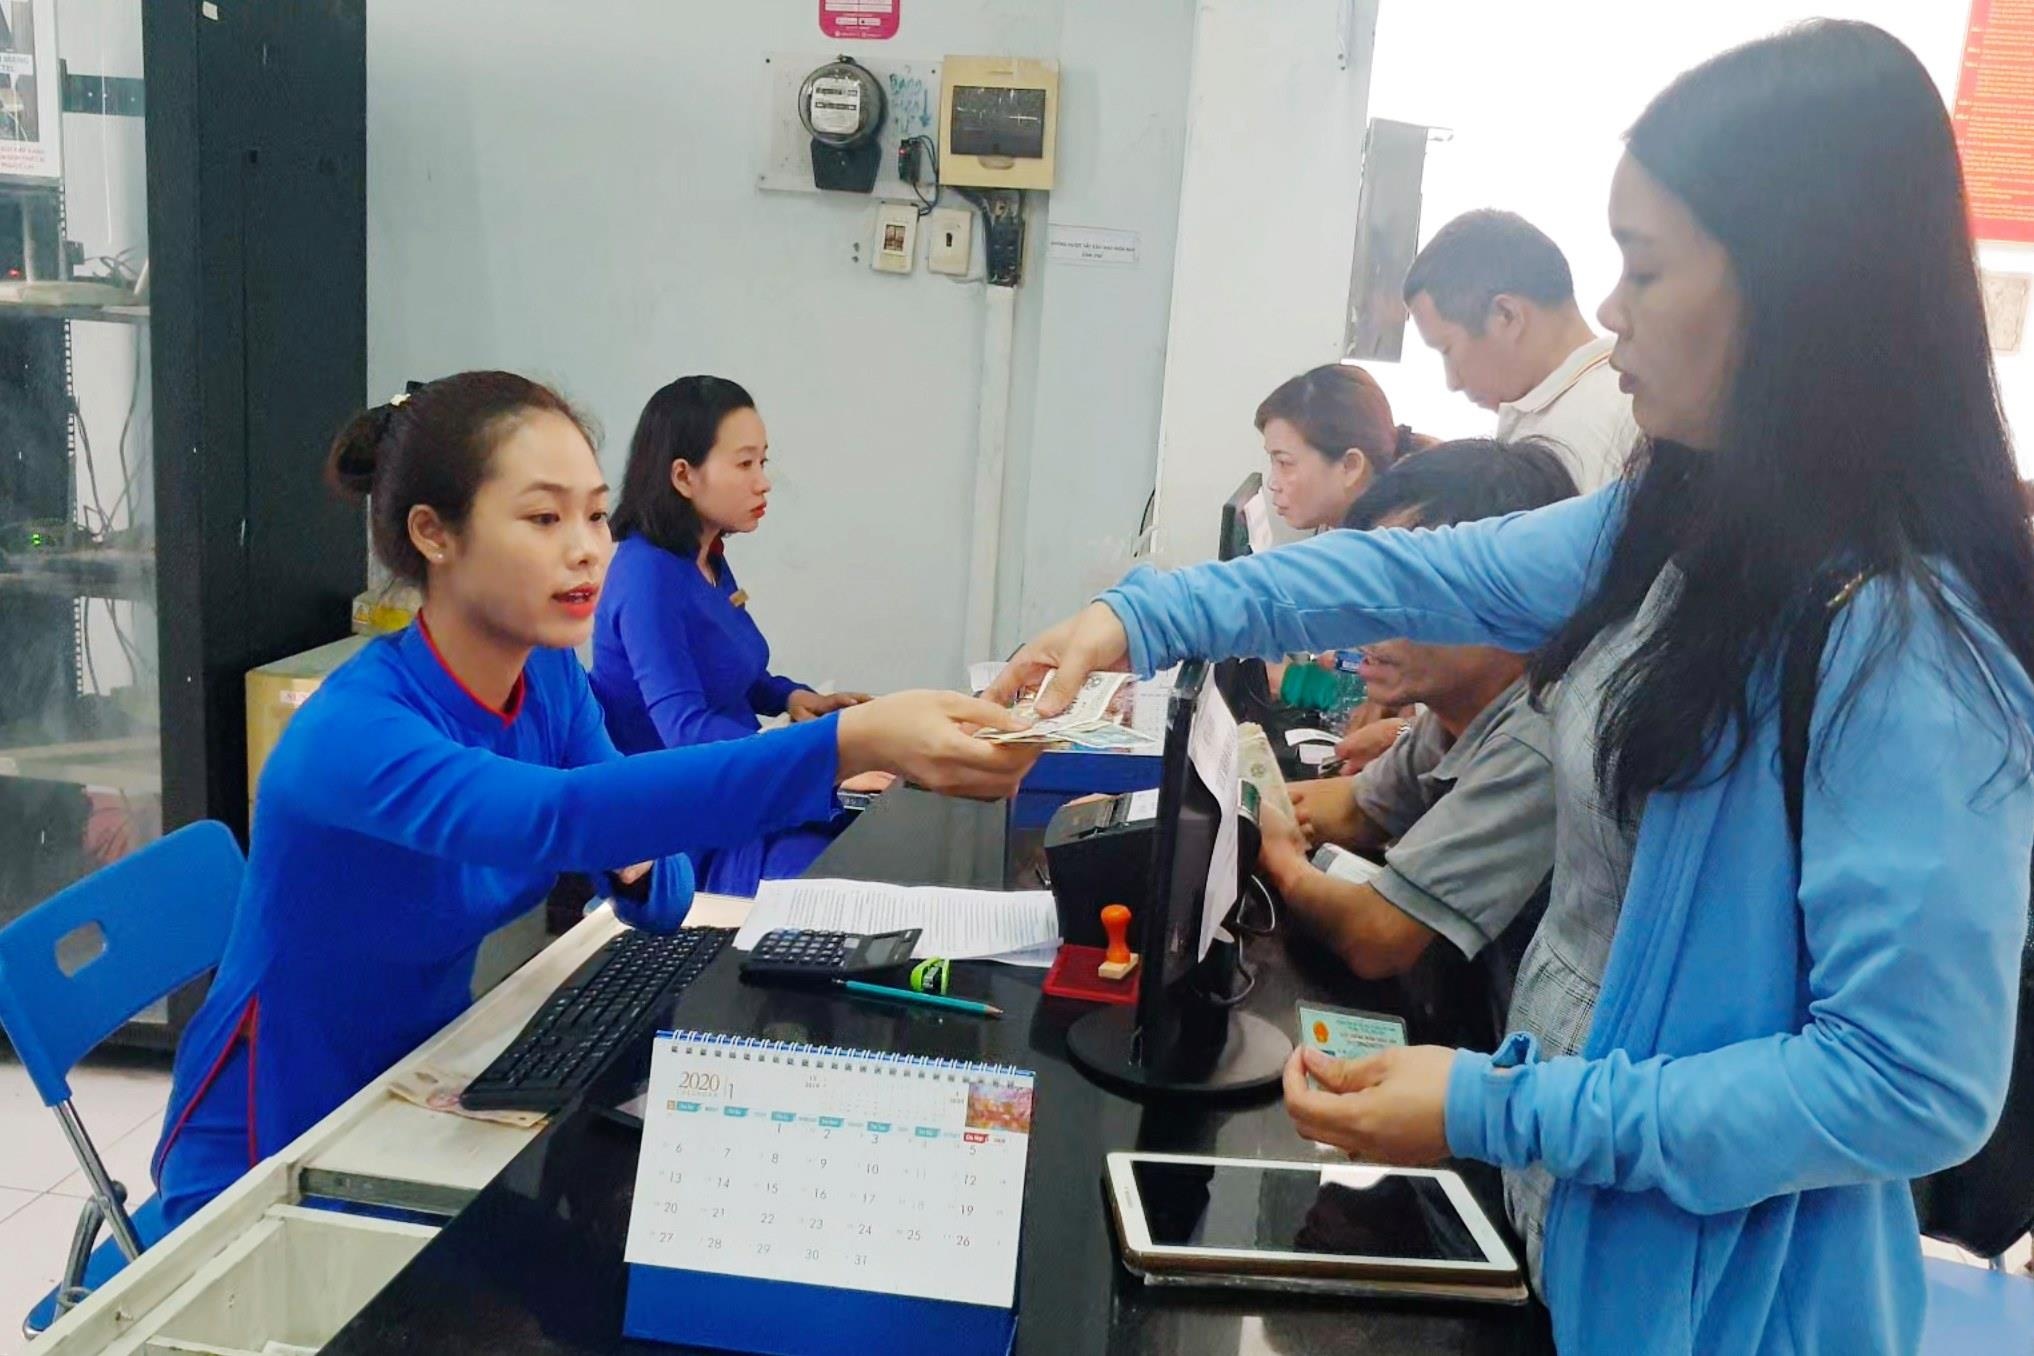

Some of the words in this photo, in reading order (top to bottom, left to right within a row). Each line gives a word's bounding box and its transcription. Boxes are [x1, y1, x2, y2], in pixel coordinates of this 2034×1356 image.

[679, 1071, 720, 1091] 2020
[729, 1083, 734, 1099] 1
[823, 1128, 831, 1140] 2
[872, 1134, 879, 1144] 3
[969, 1146, 976, 1155] 5
[675, 1144, 682, 1152] 6
[725, 1148, 730, 1158] 7
[771, 1153, 778, 1163] 8
[820, 1158, 827, 1168] 9
[866, 1164, 879, 1174] 10
[964, 1175, 976, 1185] 12
[669, 1172, 682, 1183] 13
[717, 1177, 729, 1187] 14
[766, 1183, 778, 1193] 15
[815, 1188, 826, 1199] 16
[863, 1192, 875, 1203] 17
[961, 1205, 973, 1215] 19
[664, 1202, 677, 1213] 20
[712, 1207, 725, 1217] 21
[761, 1213, 775, 1223] 22
[809, 1219, 823, 1229] 23
[858, 1224, 871, 1234] 24
[907, 1230, 921, 1240] 25
[956, 1236, 970, 1246] 26
[659, 1232, 674, 1242] 27
[708, 1238, 721, 1248] 28
[805, 1249, 819, 1260] 30
[854, 1255, 866, 1265] 31
